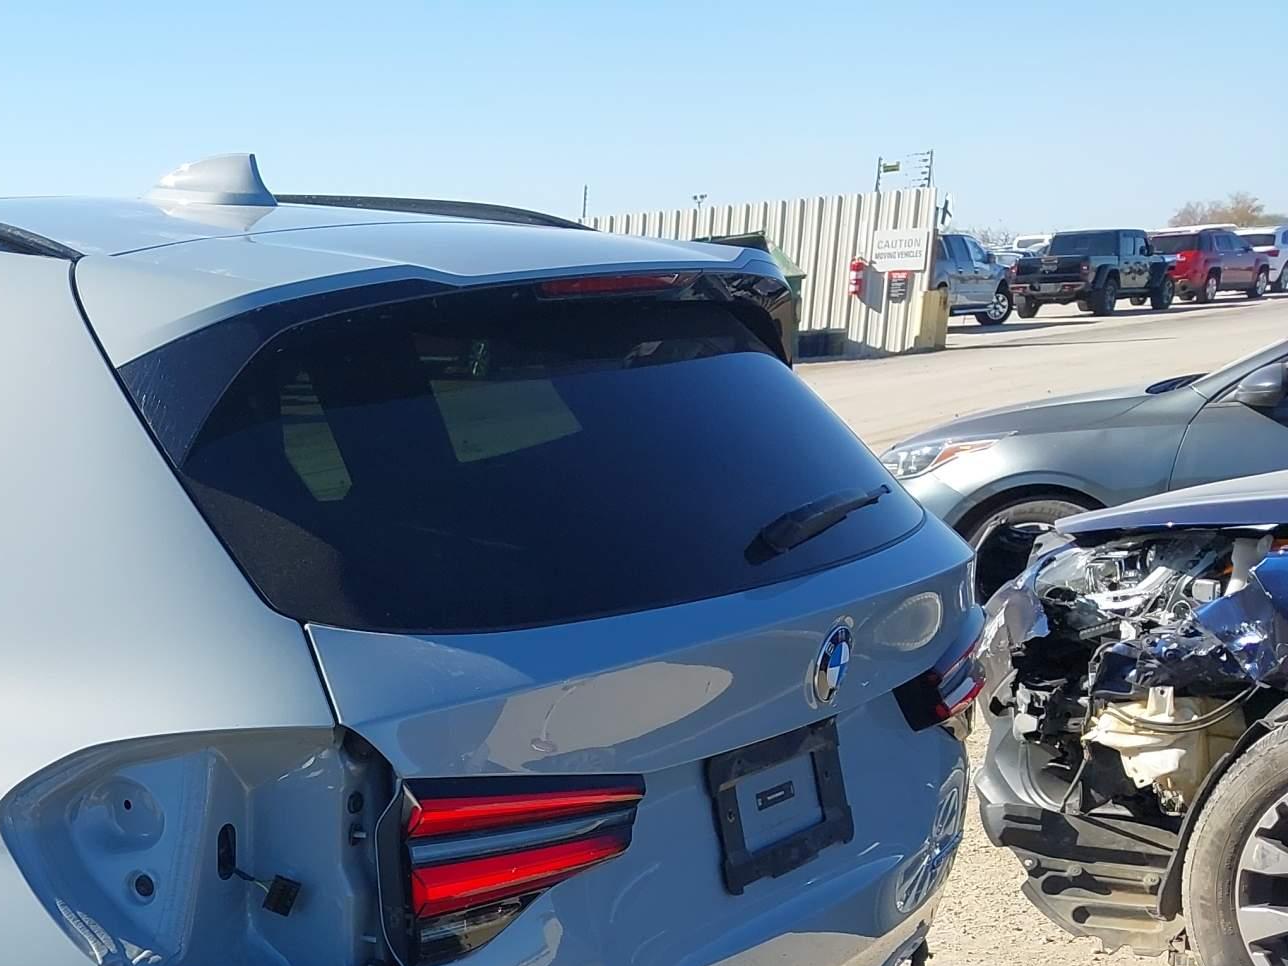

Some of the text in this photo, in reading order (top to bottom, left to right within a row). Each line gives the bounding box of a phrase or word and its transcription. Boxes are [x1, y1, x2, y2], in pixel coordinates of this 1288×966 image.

[877, 238, 921, 249] CAUTION
[875, 250, 922, 260] MOVING VEHICLES
